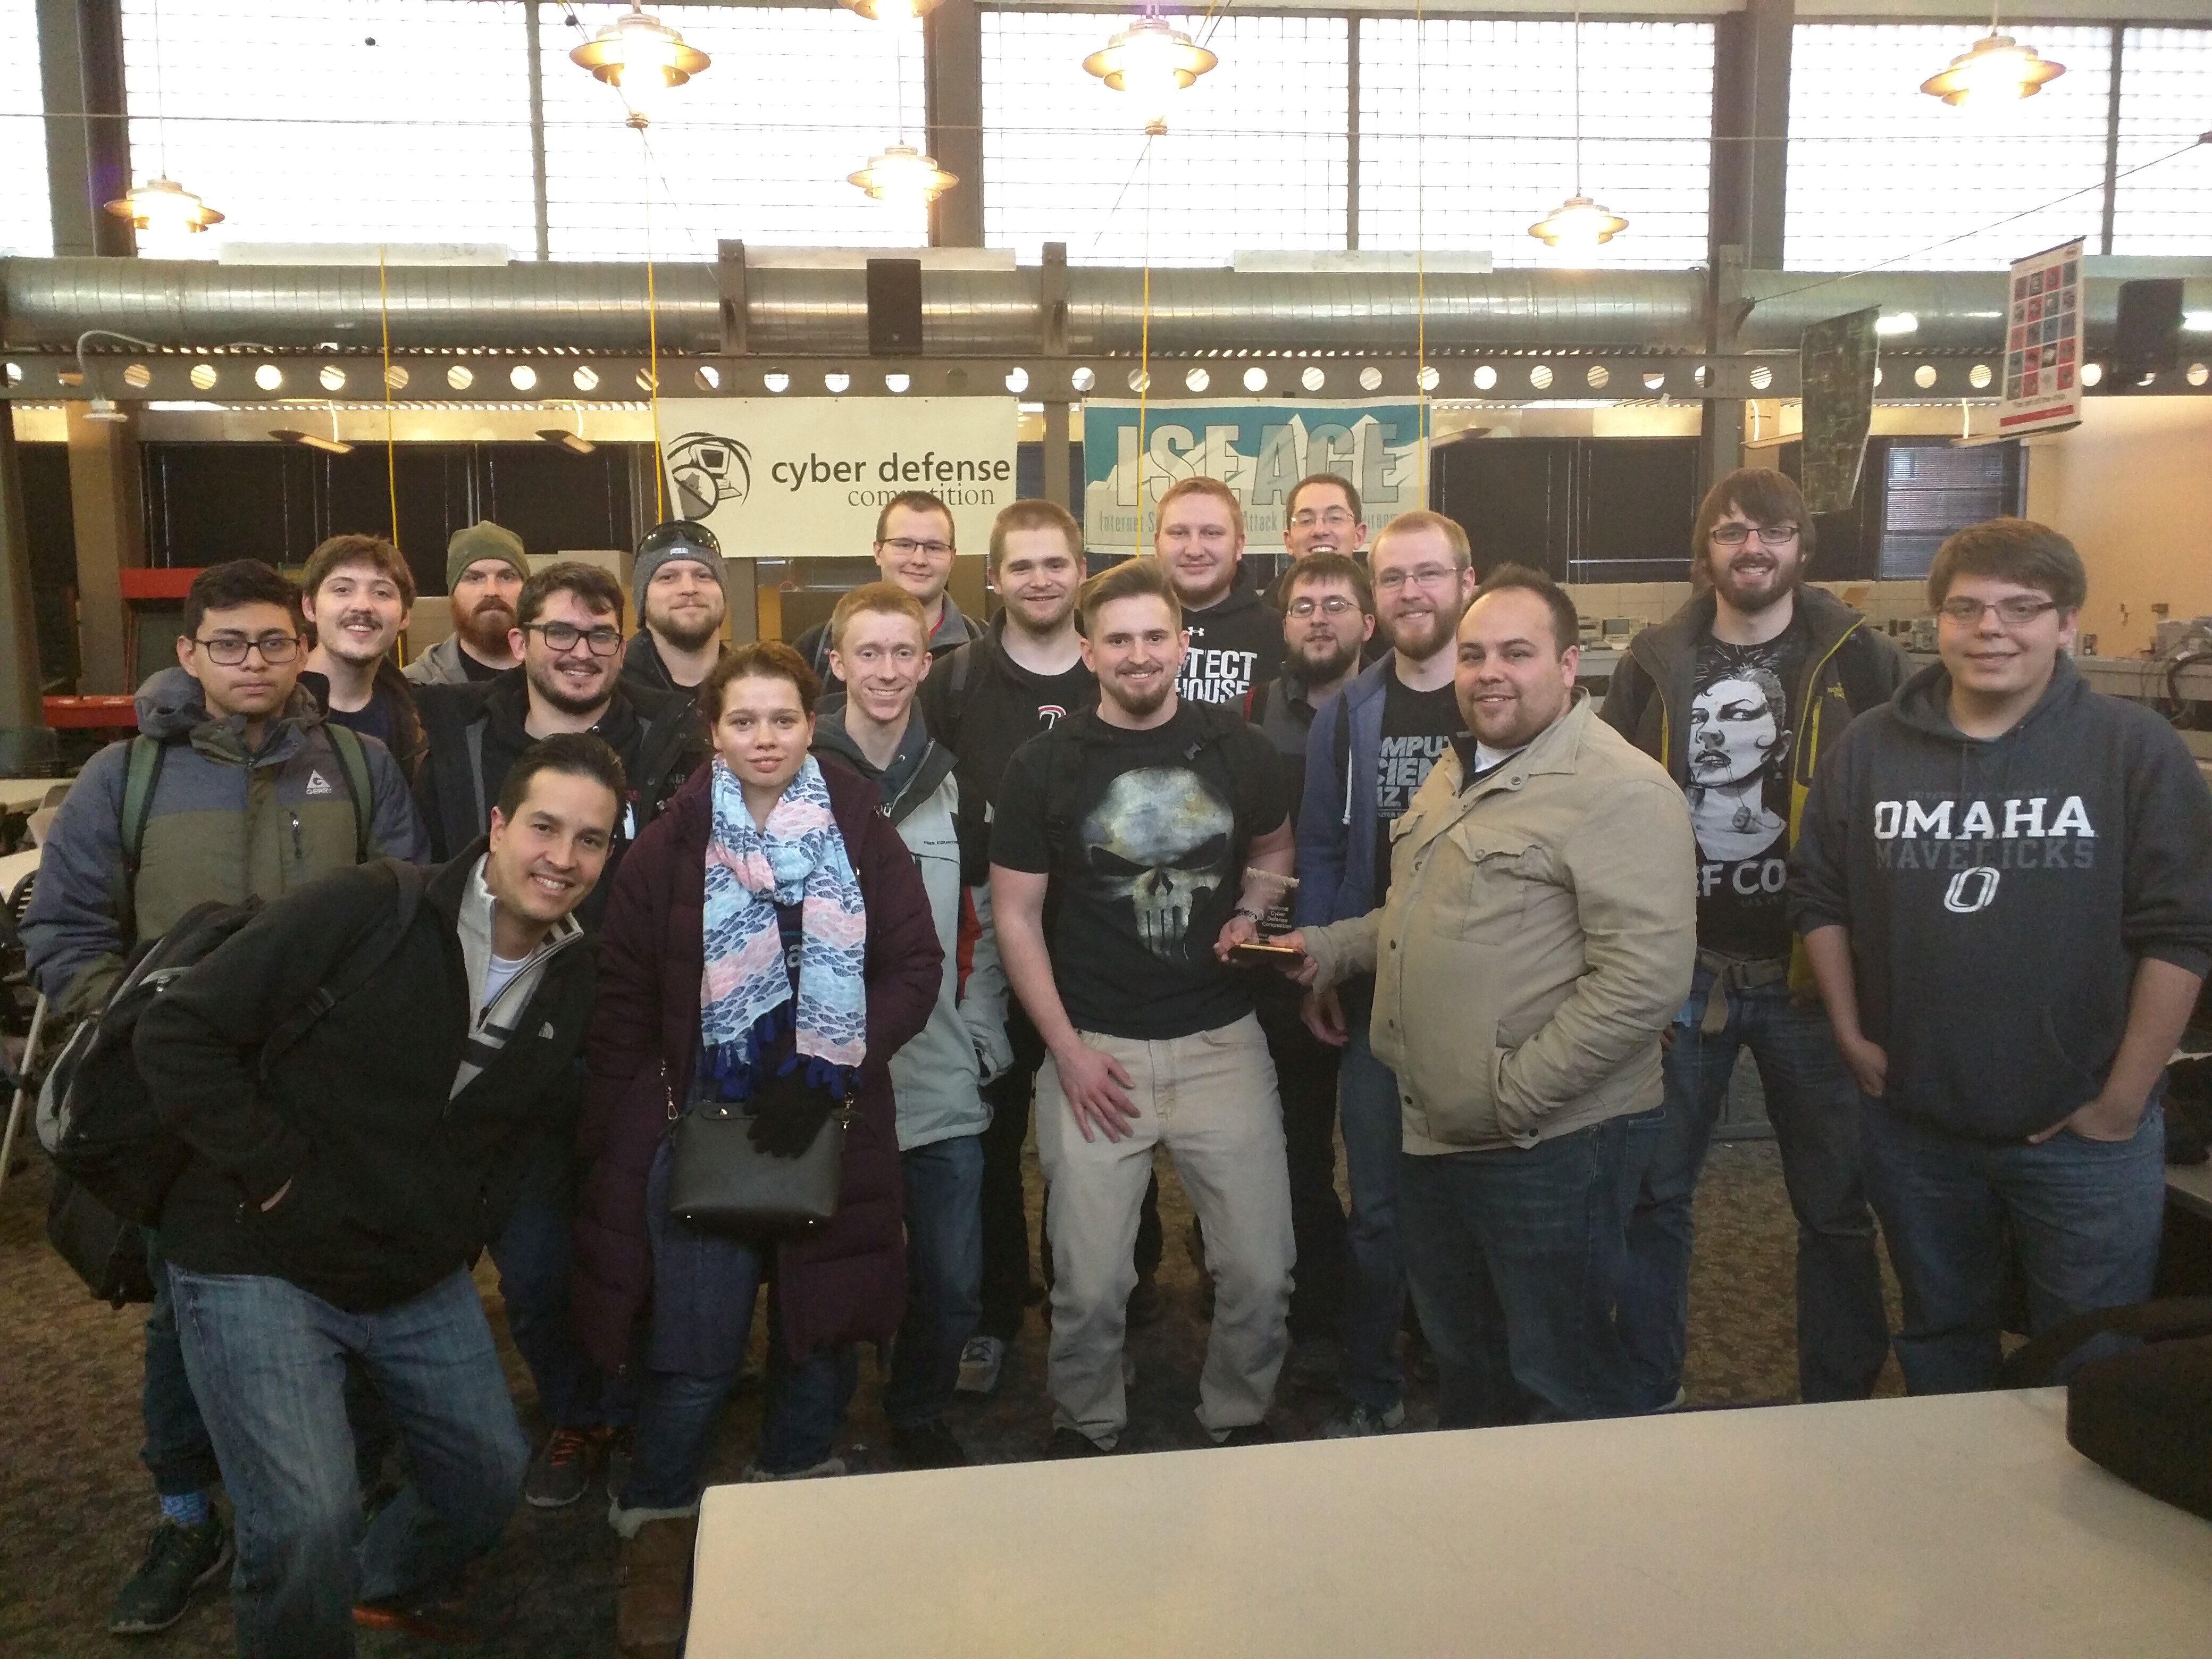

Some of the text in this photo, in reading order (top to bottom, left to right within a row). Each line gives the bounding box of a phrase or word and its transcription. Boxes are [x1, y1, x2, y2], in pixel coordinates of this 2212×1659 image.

[771, 451, 1011, 492] cyber defense
[1117, 423, 1398, 507] ISEAGE
[848, 483, 995, 507] comition
[1176, 647, 1258, 681] TECT
[1874, 796, 2095, 840] OMAHA
[1732, 858, 1787, 895] CO
